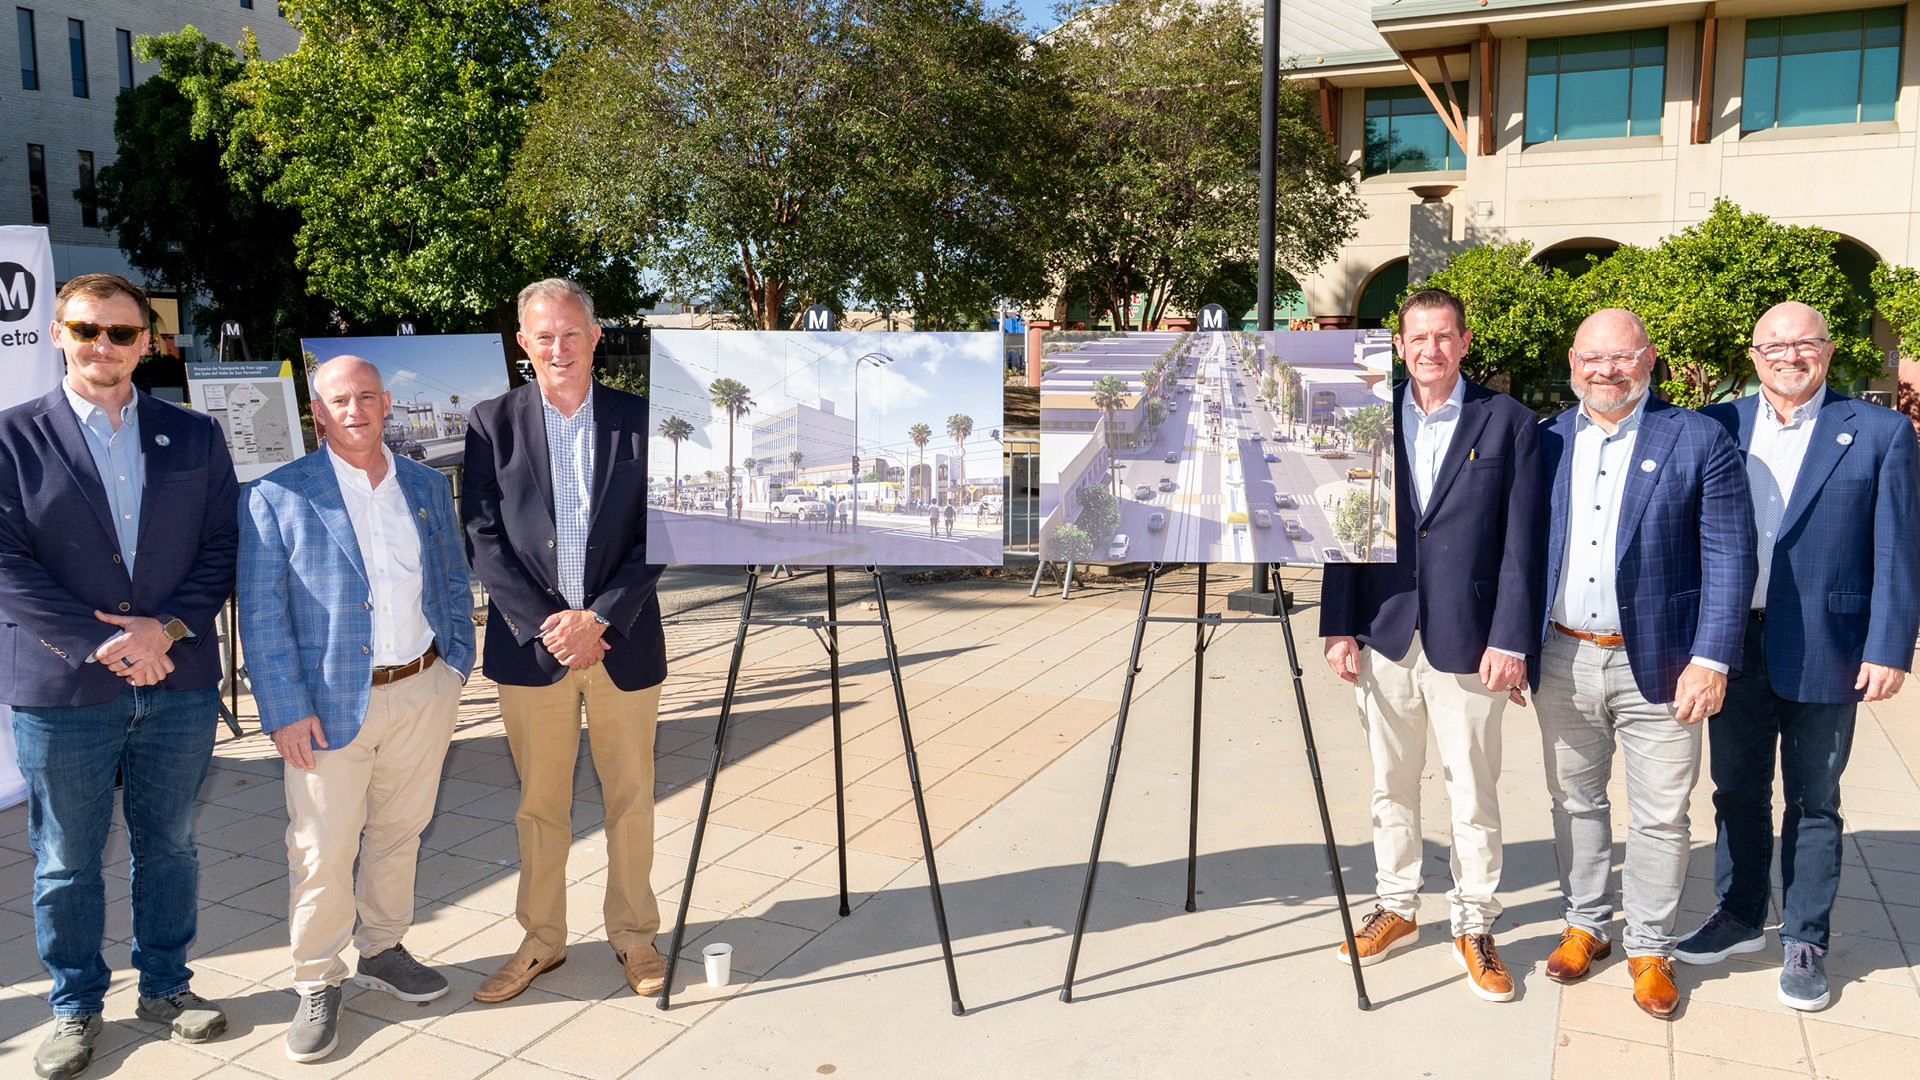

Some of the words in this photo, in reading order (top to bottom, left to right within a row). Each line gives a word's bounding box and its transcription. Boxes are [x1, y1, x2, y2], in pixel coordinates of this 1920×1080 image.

[0, 271, 29, 310] M
[809, 310, 829, 329] M
[1203, 309, 1223, 328] M
[1, 329, 39, 346] etro
[226, 323, 240, 336] M
[401, 323, 414, 335] M
